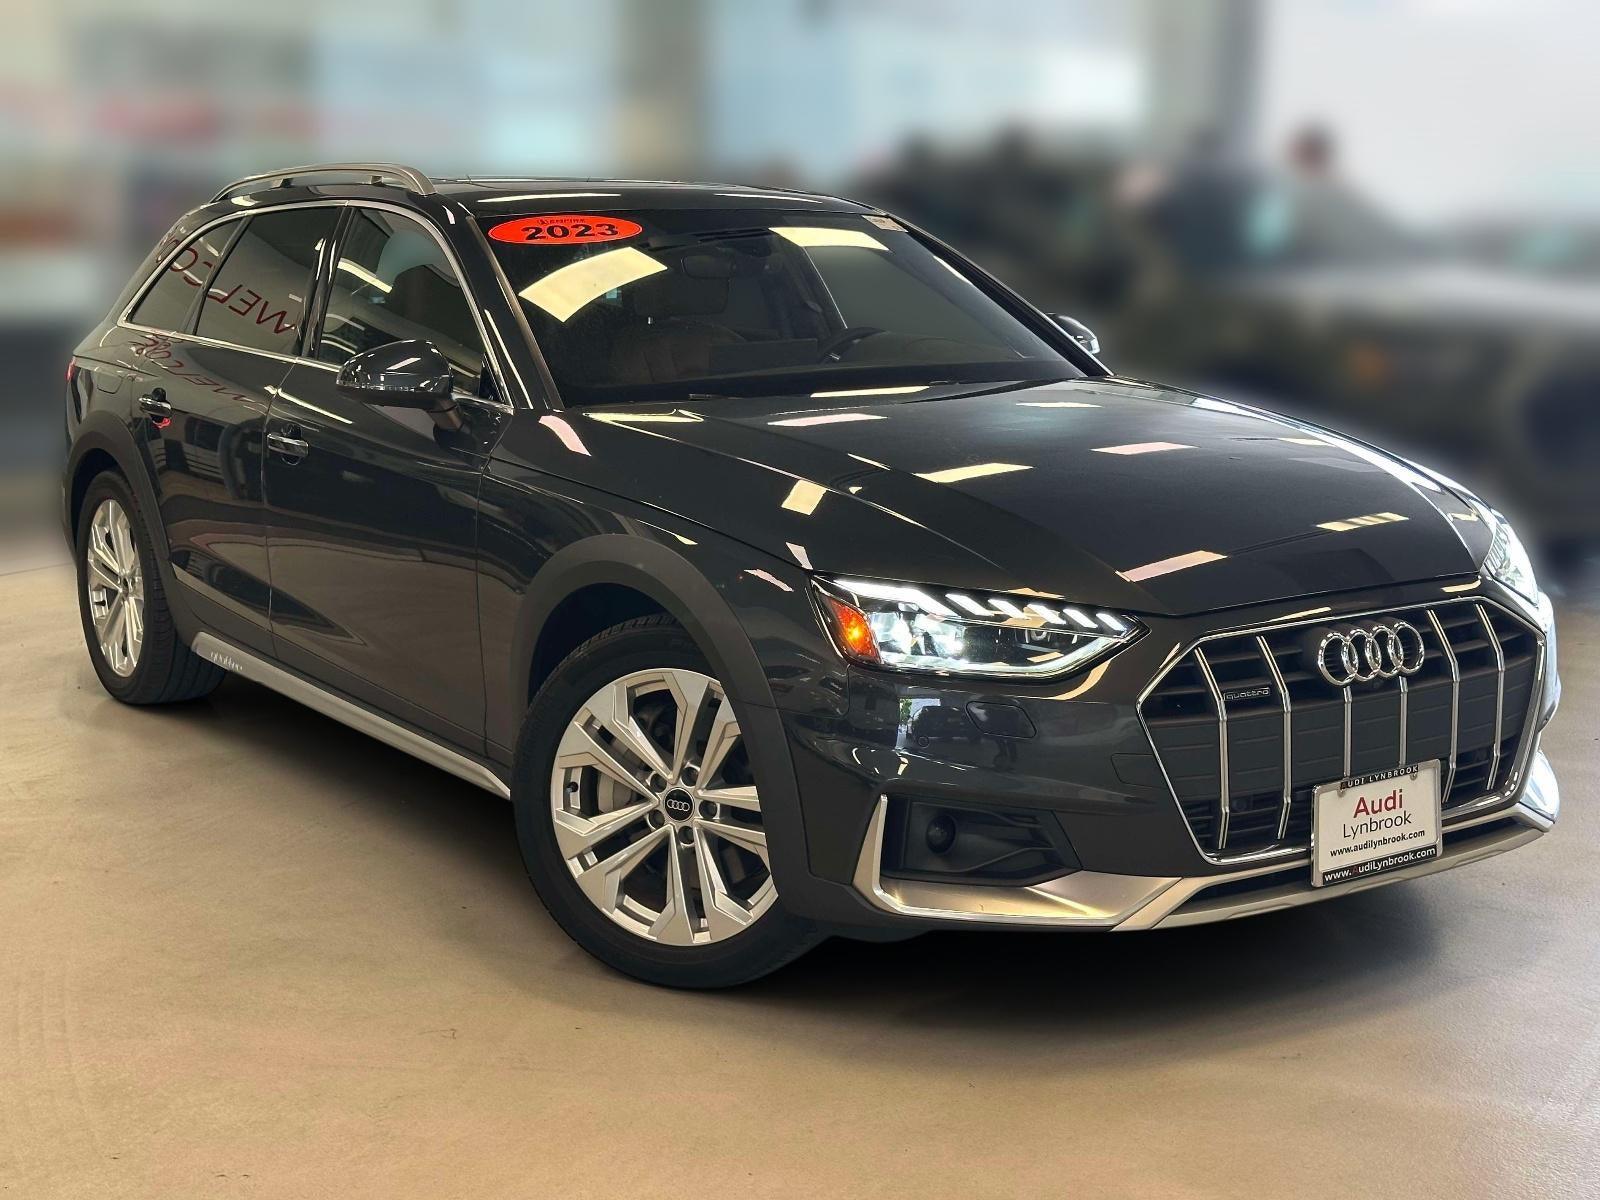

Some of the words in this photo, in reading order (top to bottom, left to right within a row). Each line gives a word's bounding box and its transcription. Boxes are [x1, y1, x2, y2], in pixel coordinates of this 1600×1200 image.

[521, 223, 620, 240] 2023
[1226, 689, 1269, 700] quattro
[1340, 777, 1365, 790] AUDI
[1369, 765, 1418, 782] LYNBROOK
[1353, 788, 1403, 818] Audi
[1343, 810, 1412, 839] Lynbrook
[1330, 830, 1425, 857] www.audilynbrook.com
